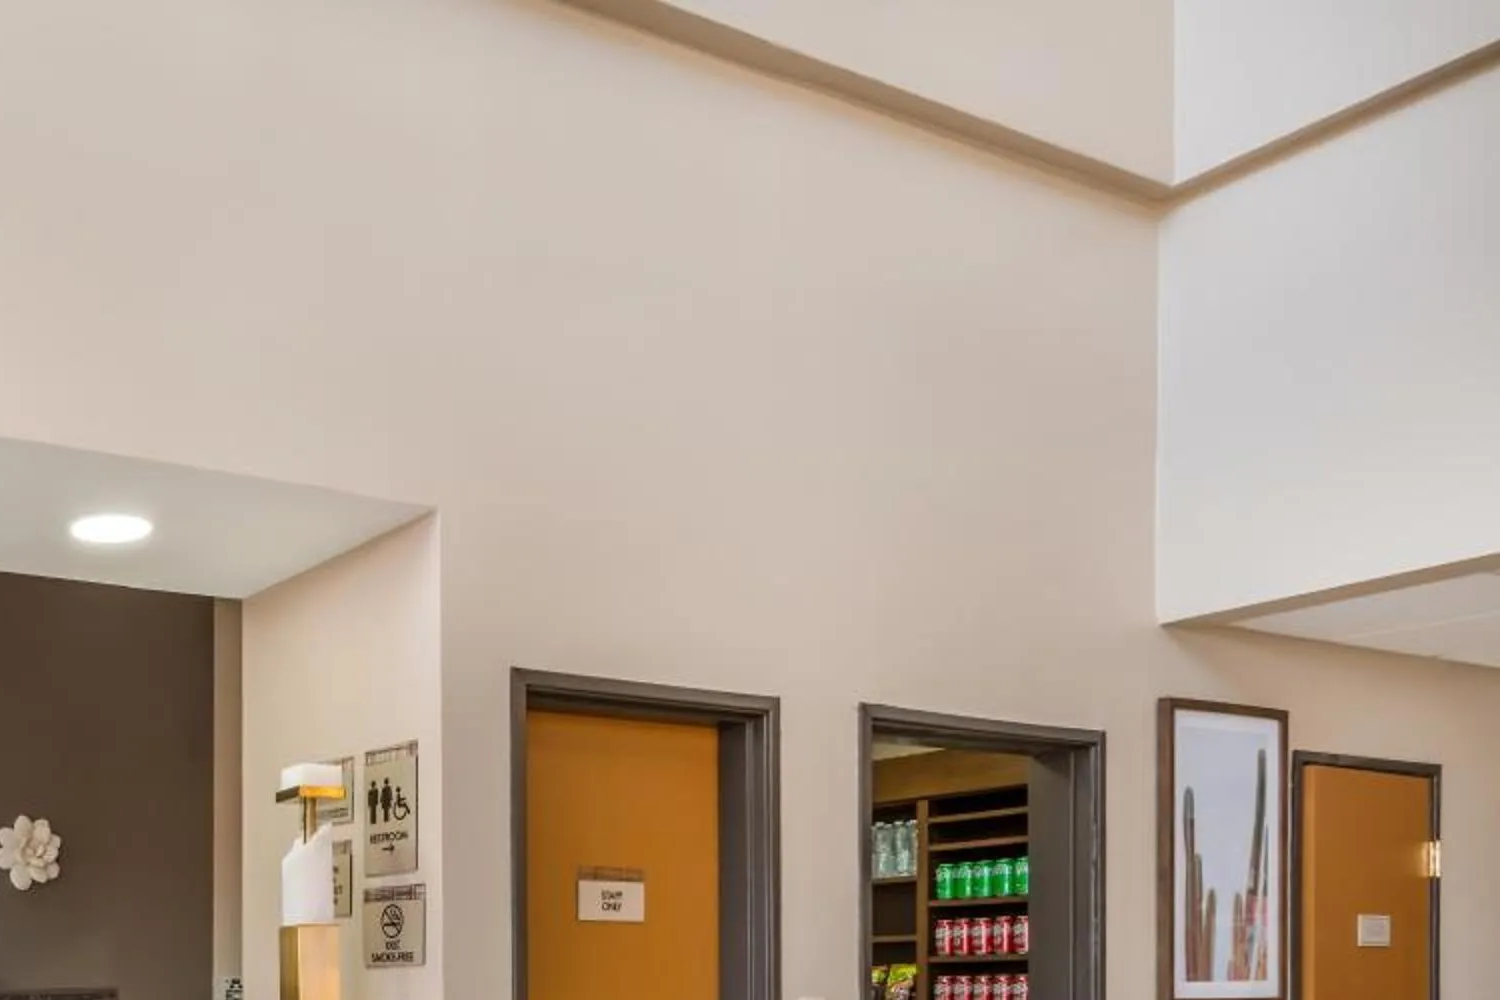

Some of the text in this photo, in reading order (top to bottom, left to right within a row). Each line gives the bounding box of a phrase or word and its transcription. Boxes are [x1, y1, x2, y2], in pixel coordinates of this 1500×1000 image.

[370, 831, 408, 844] RESTROOM
[601, 889, 623, 900] STAFF
[601, 902, 622, 912] ONLY
